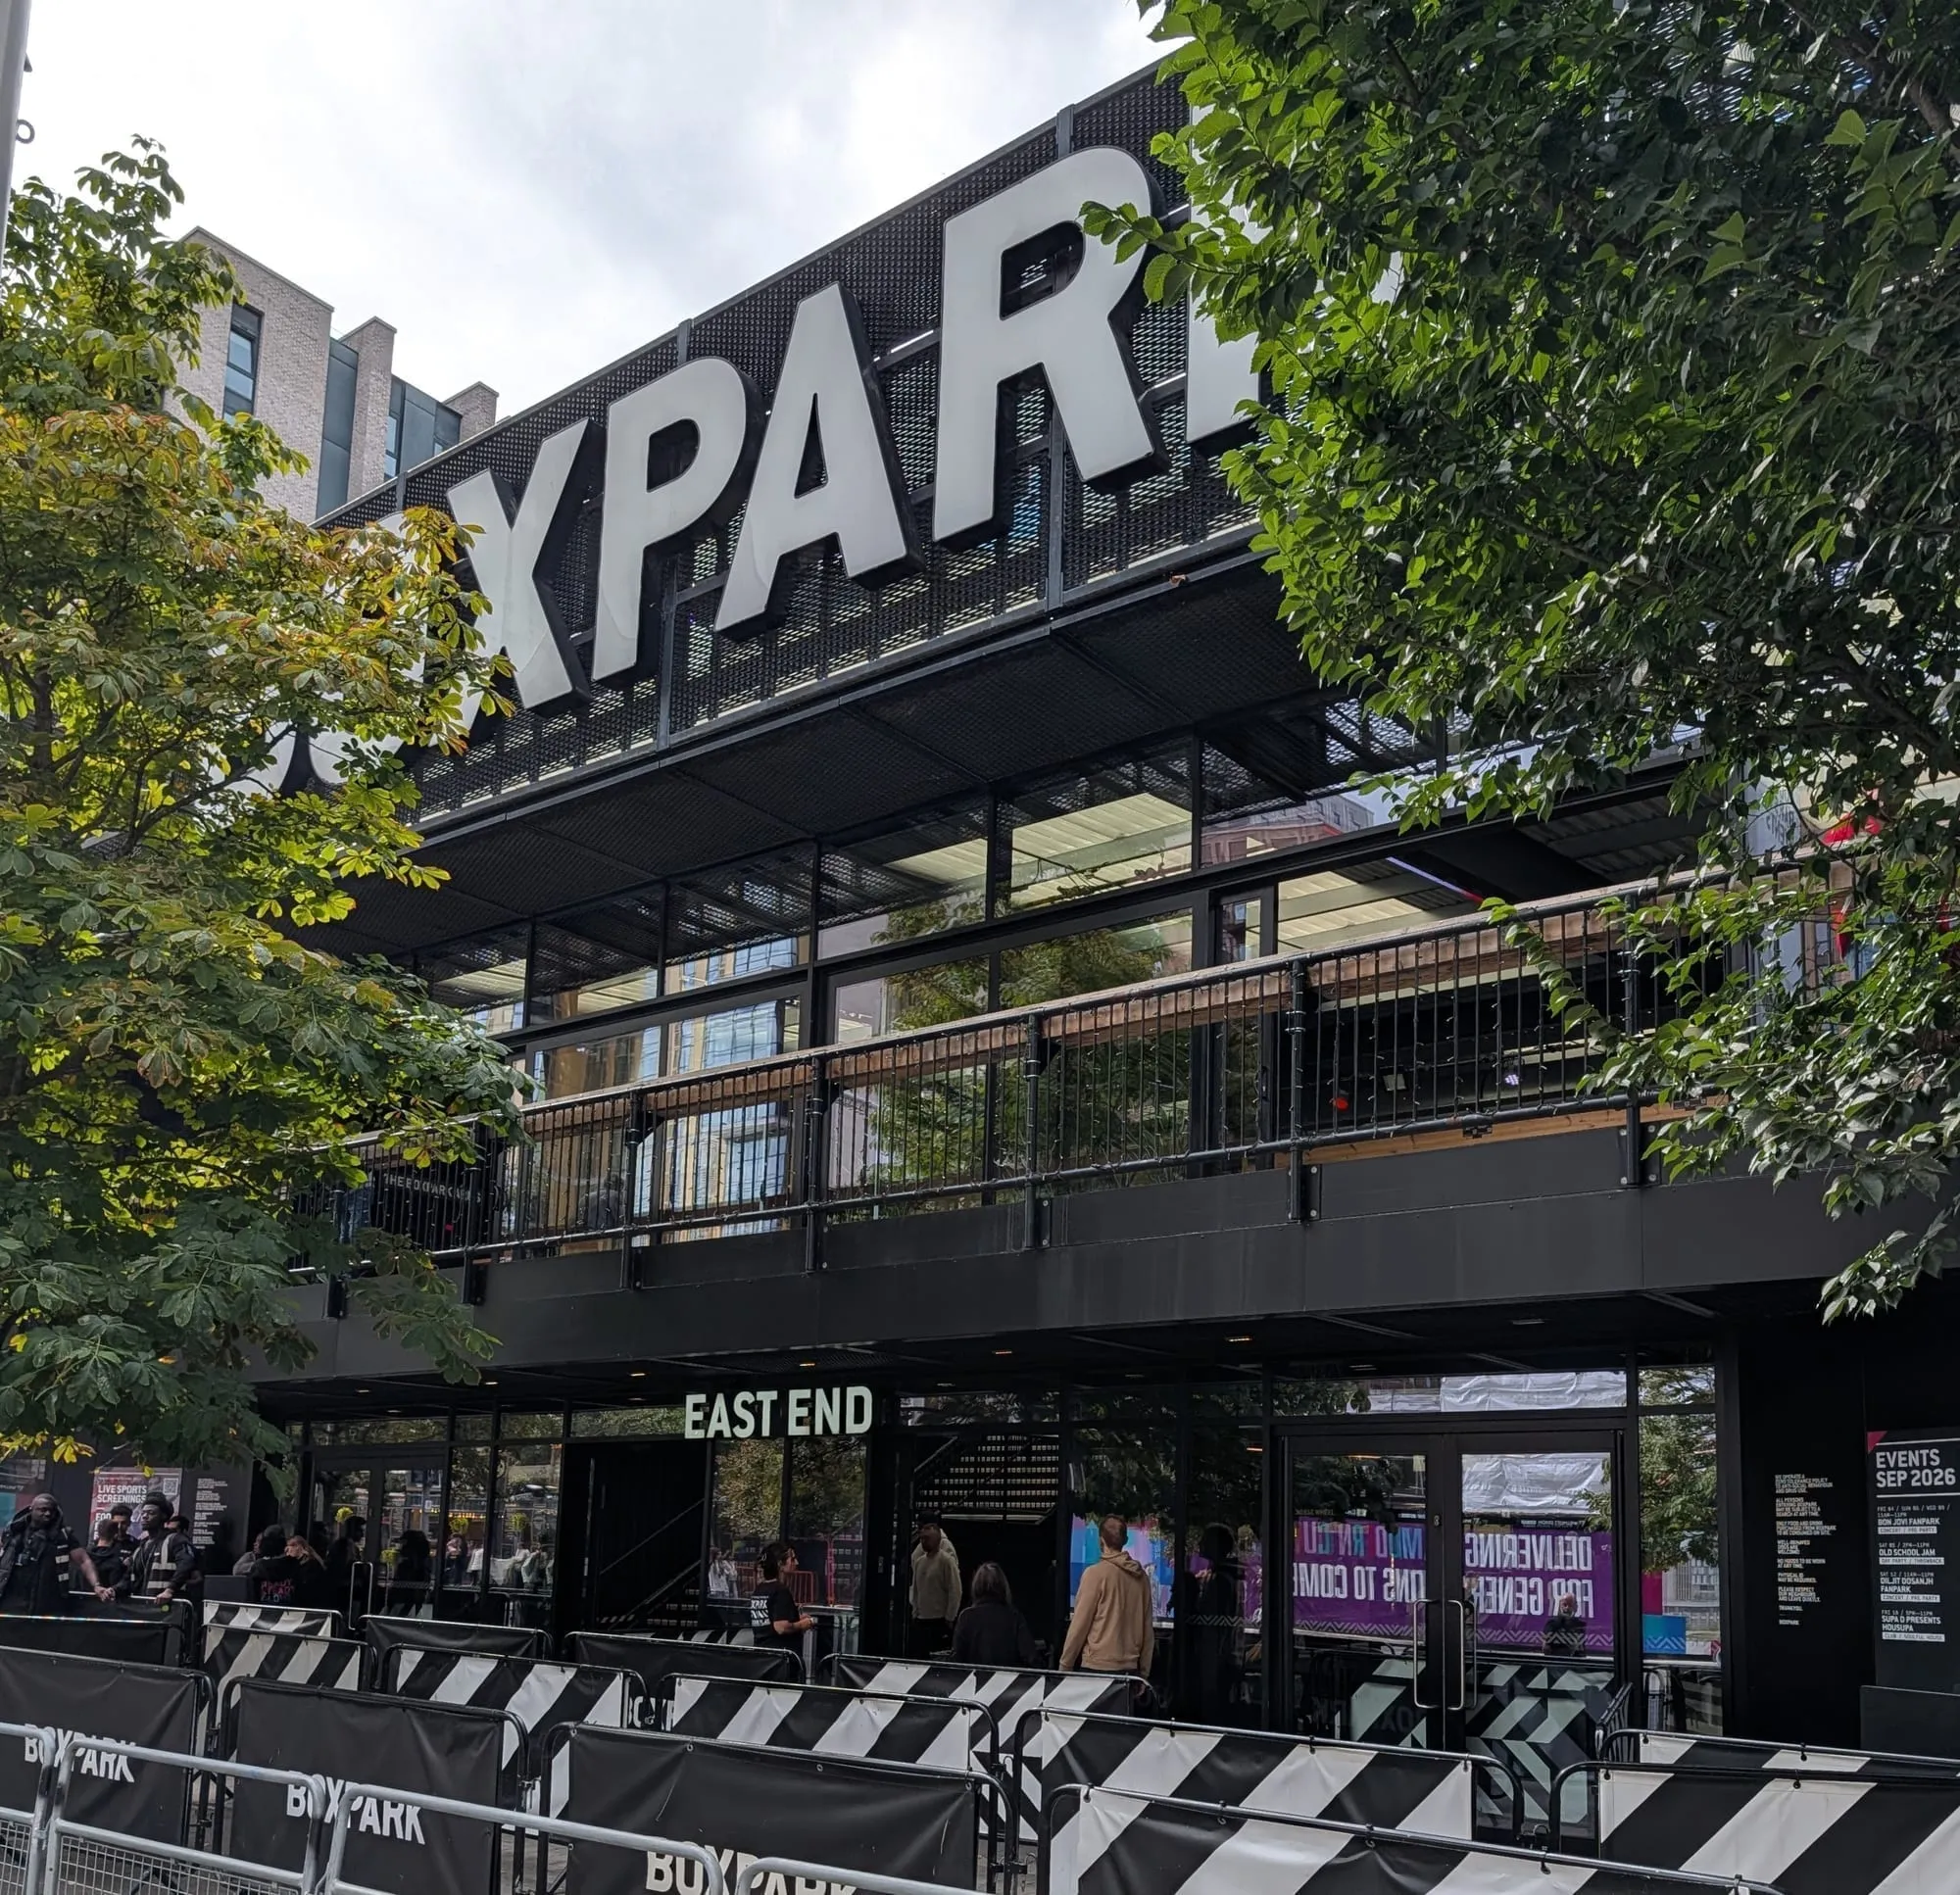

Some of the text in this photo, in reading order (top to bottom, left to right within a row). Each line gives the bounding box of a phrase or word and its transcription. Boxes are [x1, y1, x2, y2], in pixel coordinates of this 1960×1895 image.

[684, 1385, 873, 1439] EAST END
[1876, 1448, 1940, 1468] EVENTS
[1876, 1468, 1956, 1487] SEP 2026
[97, 1494, 146, 1503] SCREENINGS
[117, 1485, 147, 1494] SPORTS
[1908, 1517, 1940, 1526] FANPARK
[646, 1836, 858, 1895] BOXP
